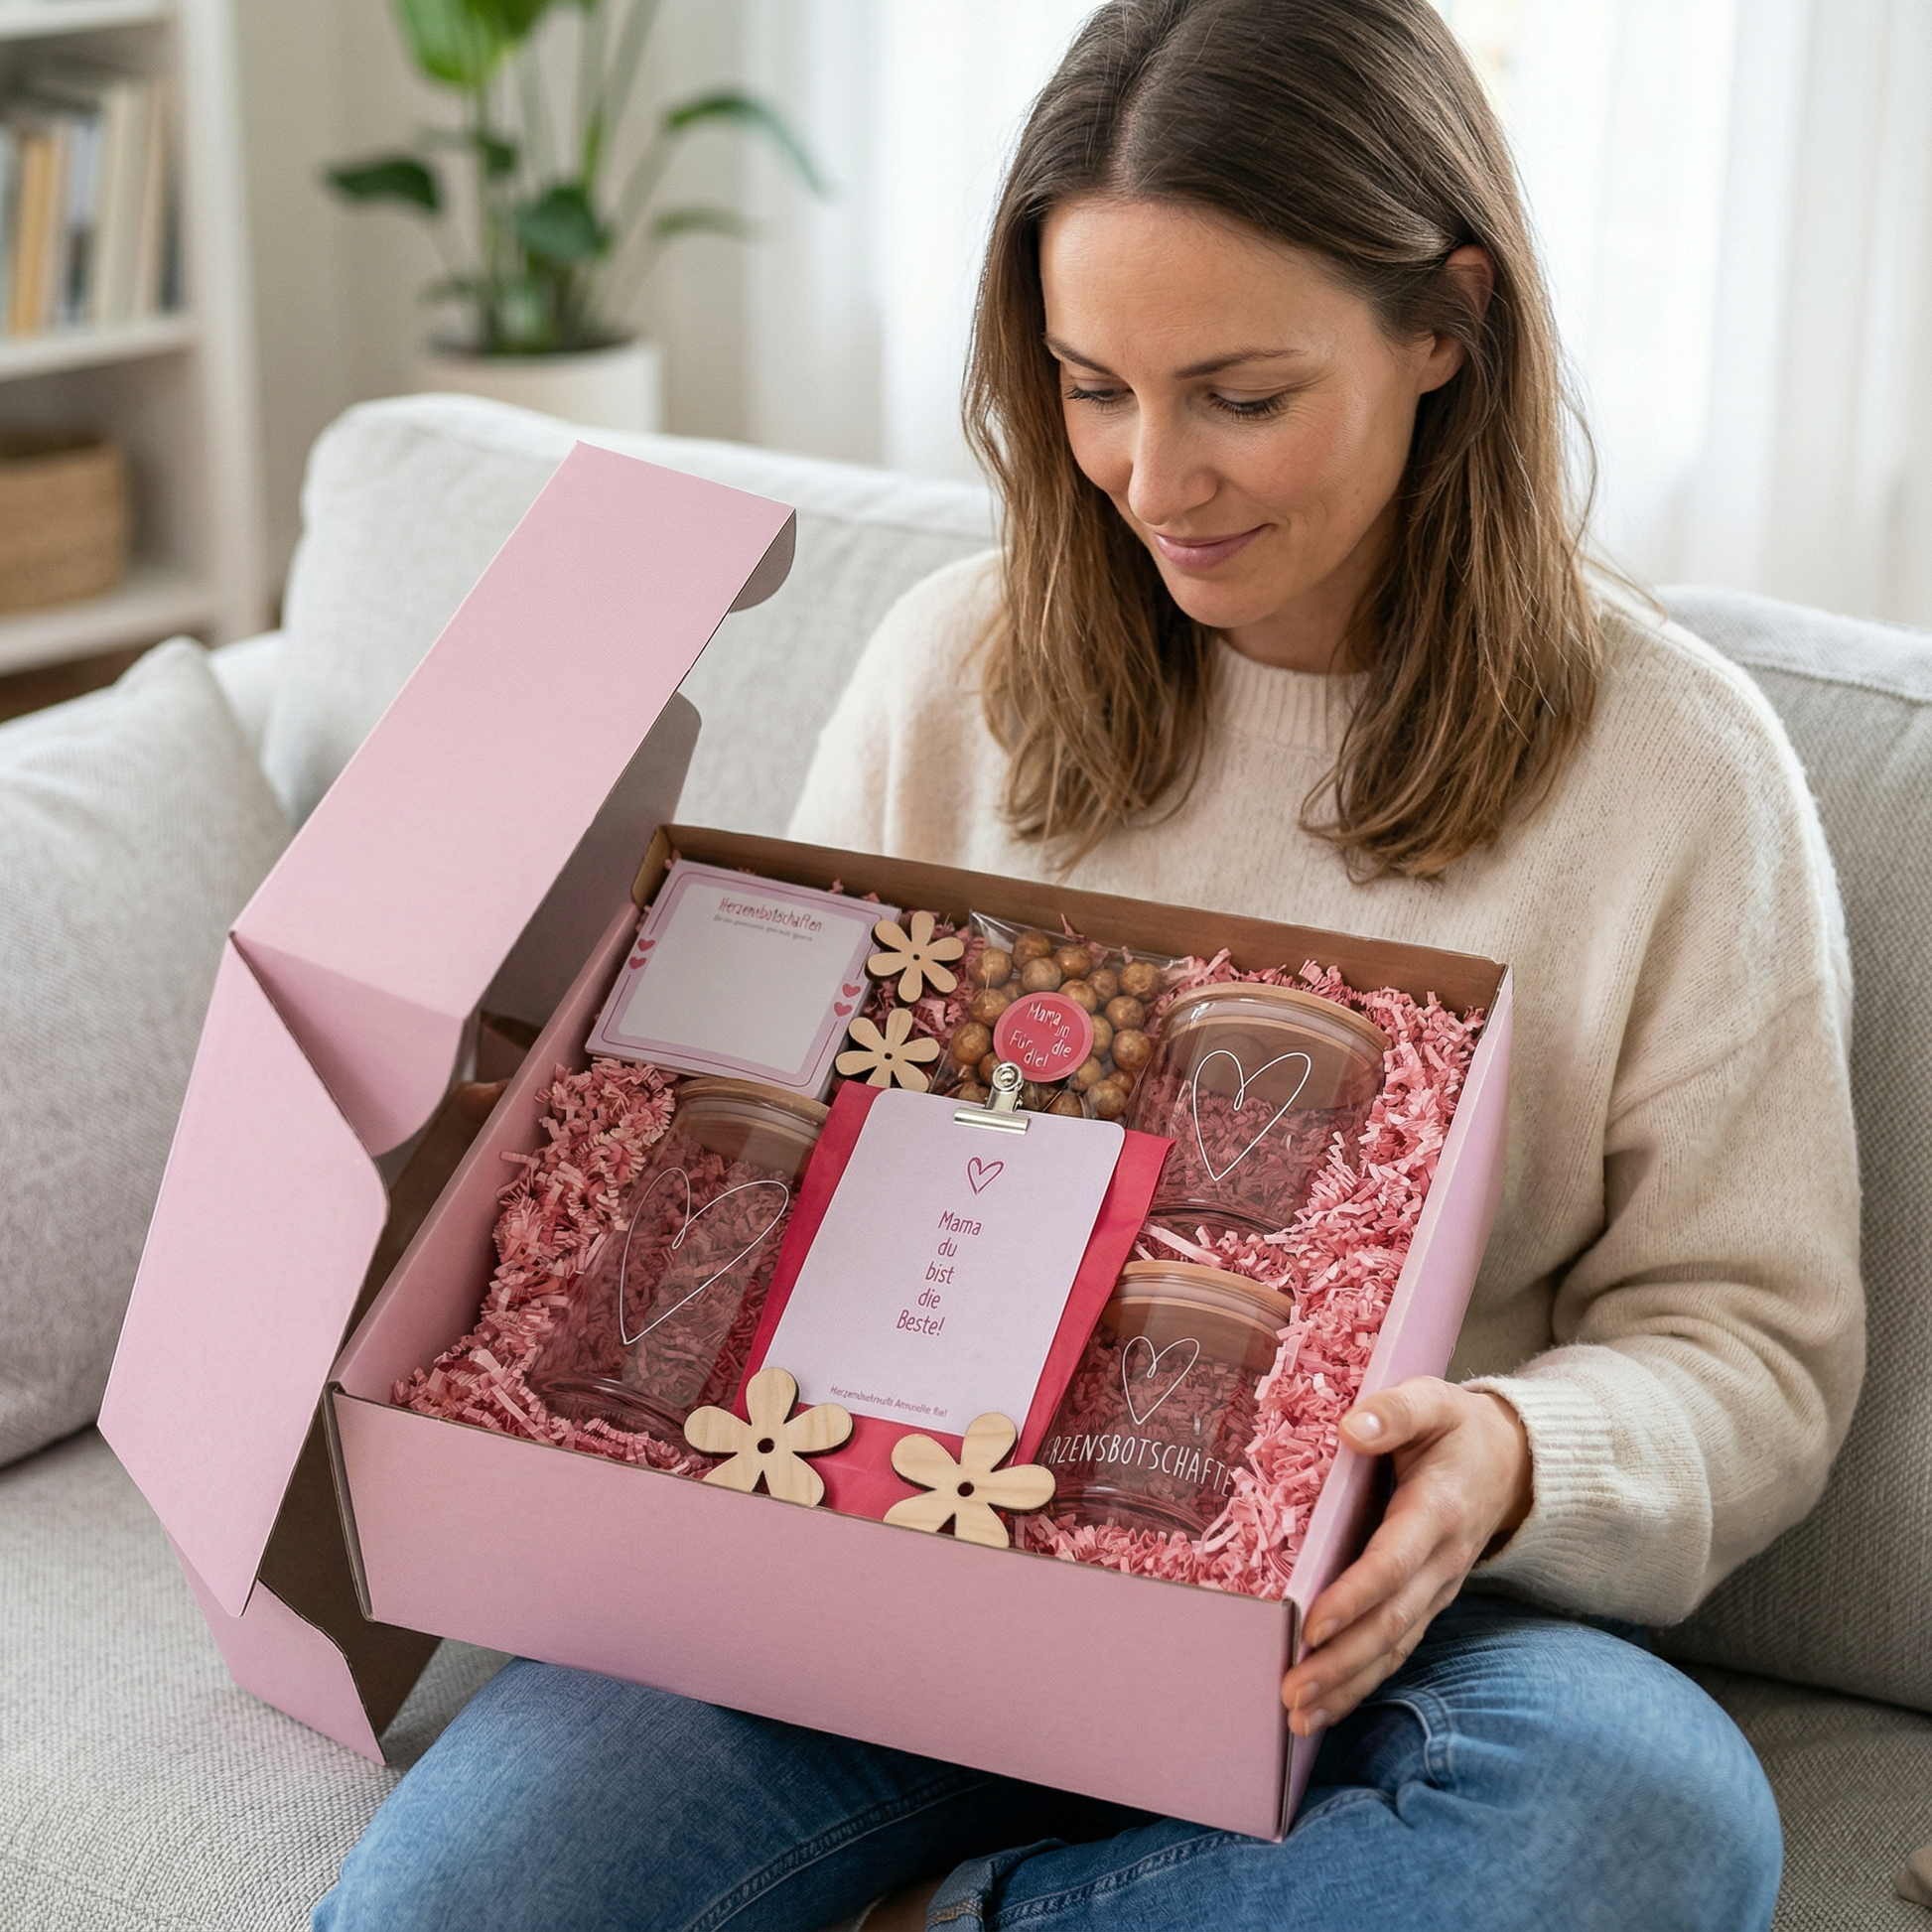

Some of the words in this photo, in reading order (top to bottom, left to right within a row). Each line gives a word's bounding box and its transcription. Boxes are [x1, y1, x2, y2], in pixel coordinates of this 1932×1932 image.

[1009, 1029, 1034, 1049] Für
[937, 1210, 982, 1236] Mama
[937, 1236, 958, 1257] du
[925, 1260, 955, 1284] bist
[917, 1287, 941, 1310] die
[897, 1309, 945, 1336] Beste!
